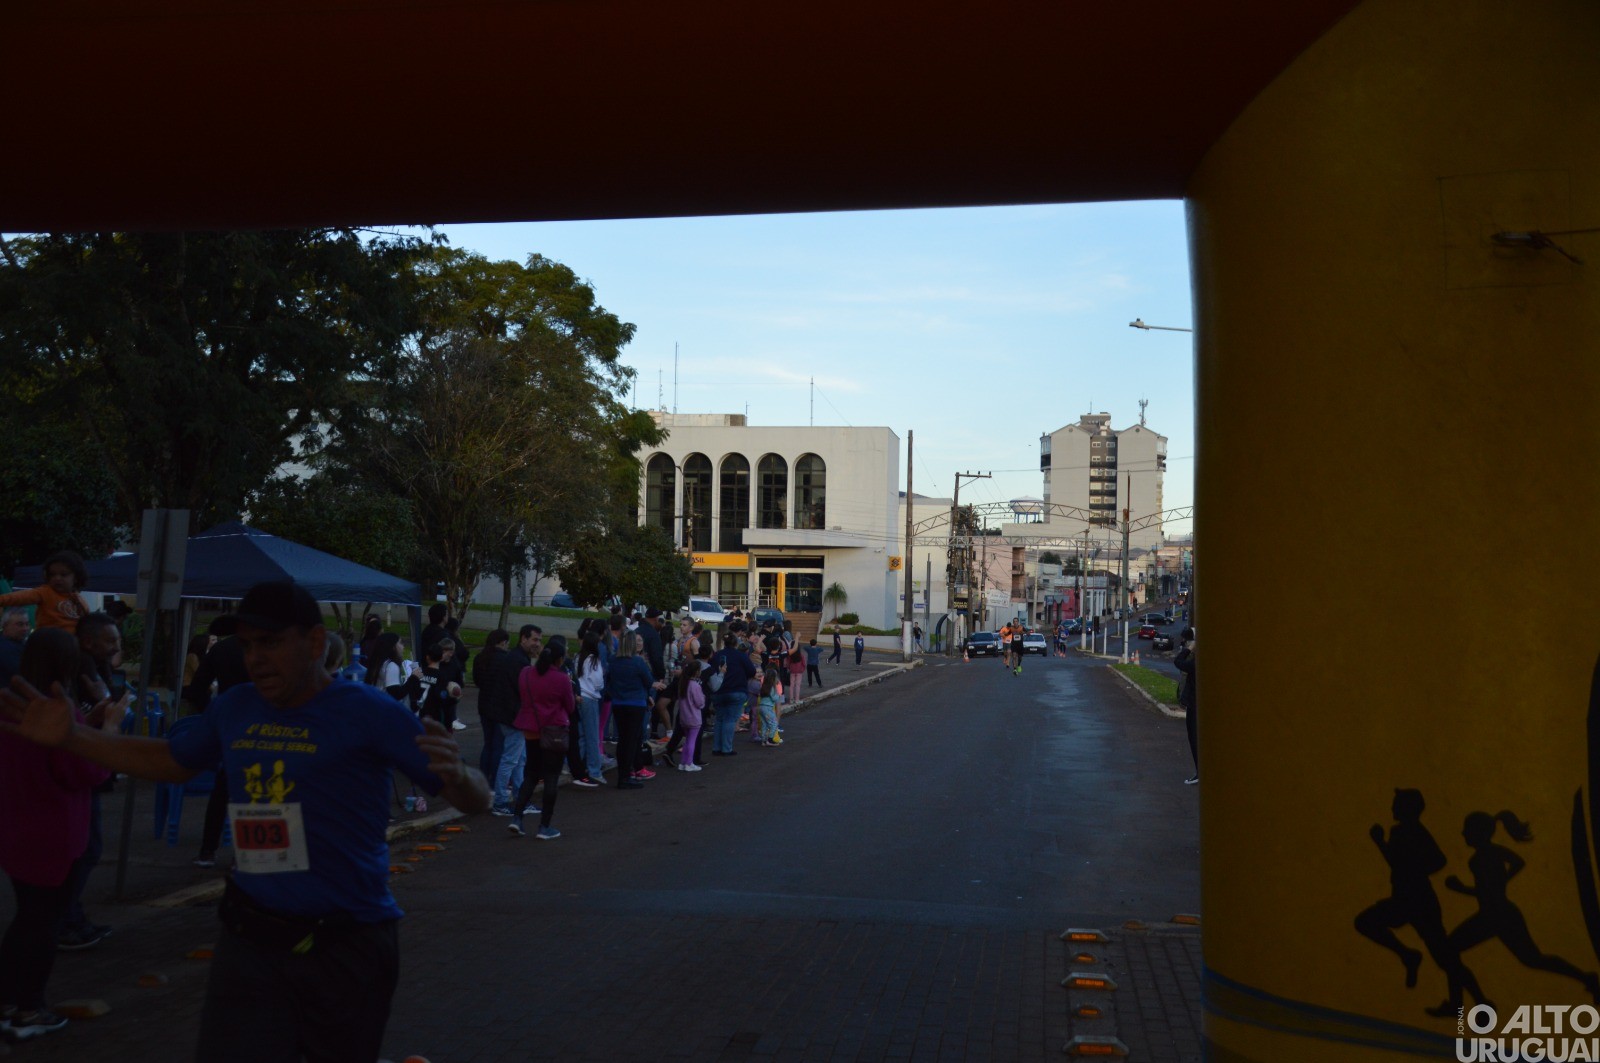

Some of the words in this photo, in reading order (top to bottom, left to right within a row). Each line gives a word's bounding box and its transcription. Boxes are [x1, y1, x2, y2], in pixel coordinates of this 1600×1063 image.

[691, 556, 706, 564] ASIL
[260, 722, 309, 738] RÚSTICA
[256, 741, 284, 751] CLUBE
[287, 742, 317, 753] SEBERI
[244, 823, 283, 845] 103
